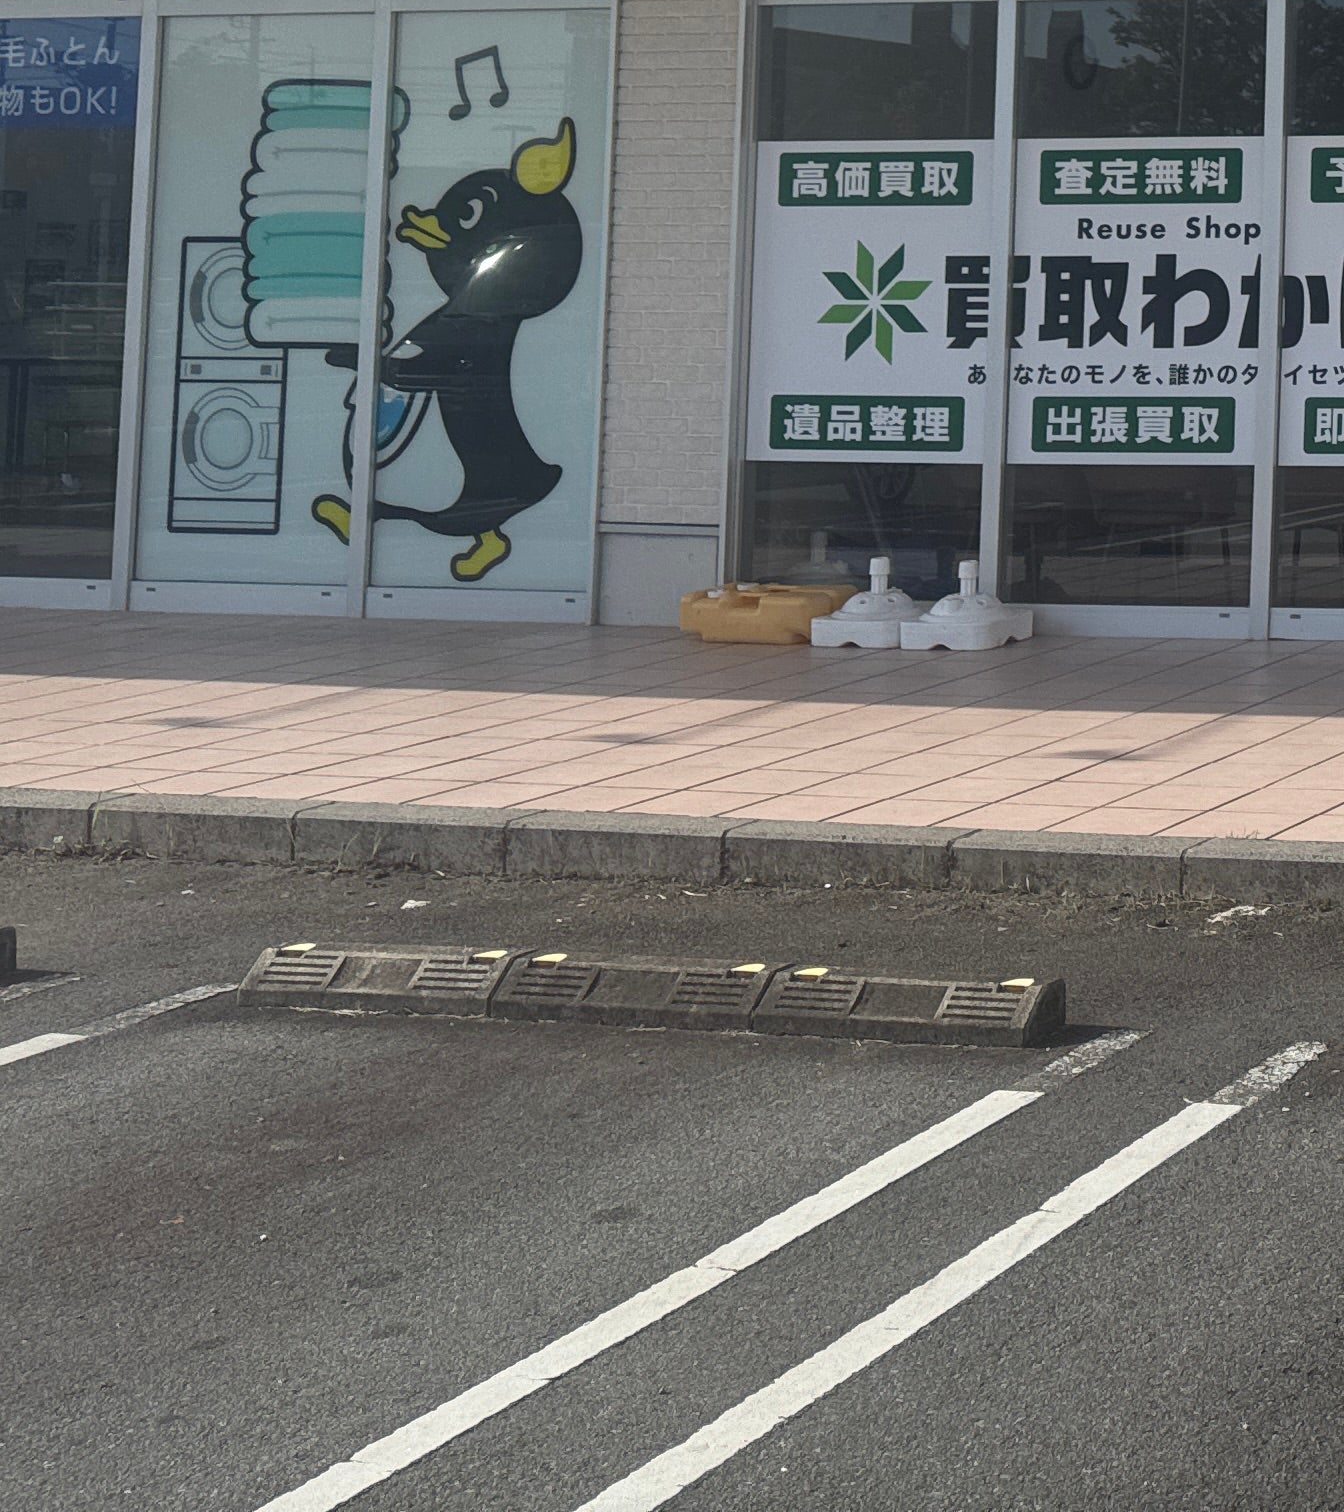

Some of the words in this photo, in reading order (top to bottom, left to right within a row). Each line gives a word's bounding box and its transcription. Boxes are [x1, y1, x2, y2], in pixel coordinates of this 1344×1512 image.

[0, 36, 120, 67] 毛ふとん
[791, 160, 960, 198] 高価買取
[1054, 157, 1229, 196] 査定無料
[1077, 218, 1166, 240] Reuse
[1186, 216, 1262, 244] Shop
[783, 406, 951, 445] 遺品整理
[1046, 405, 1221, 445] 出張買取
